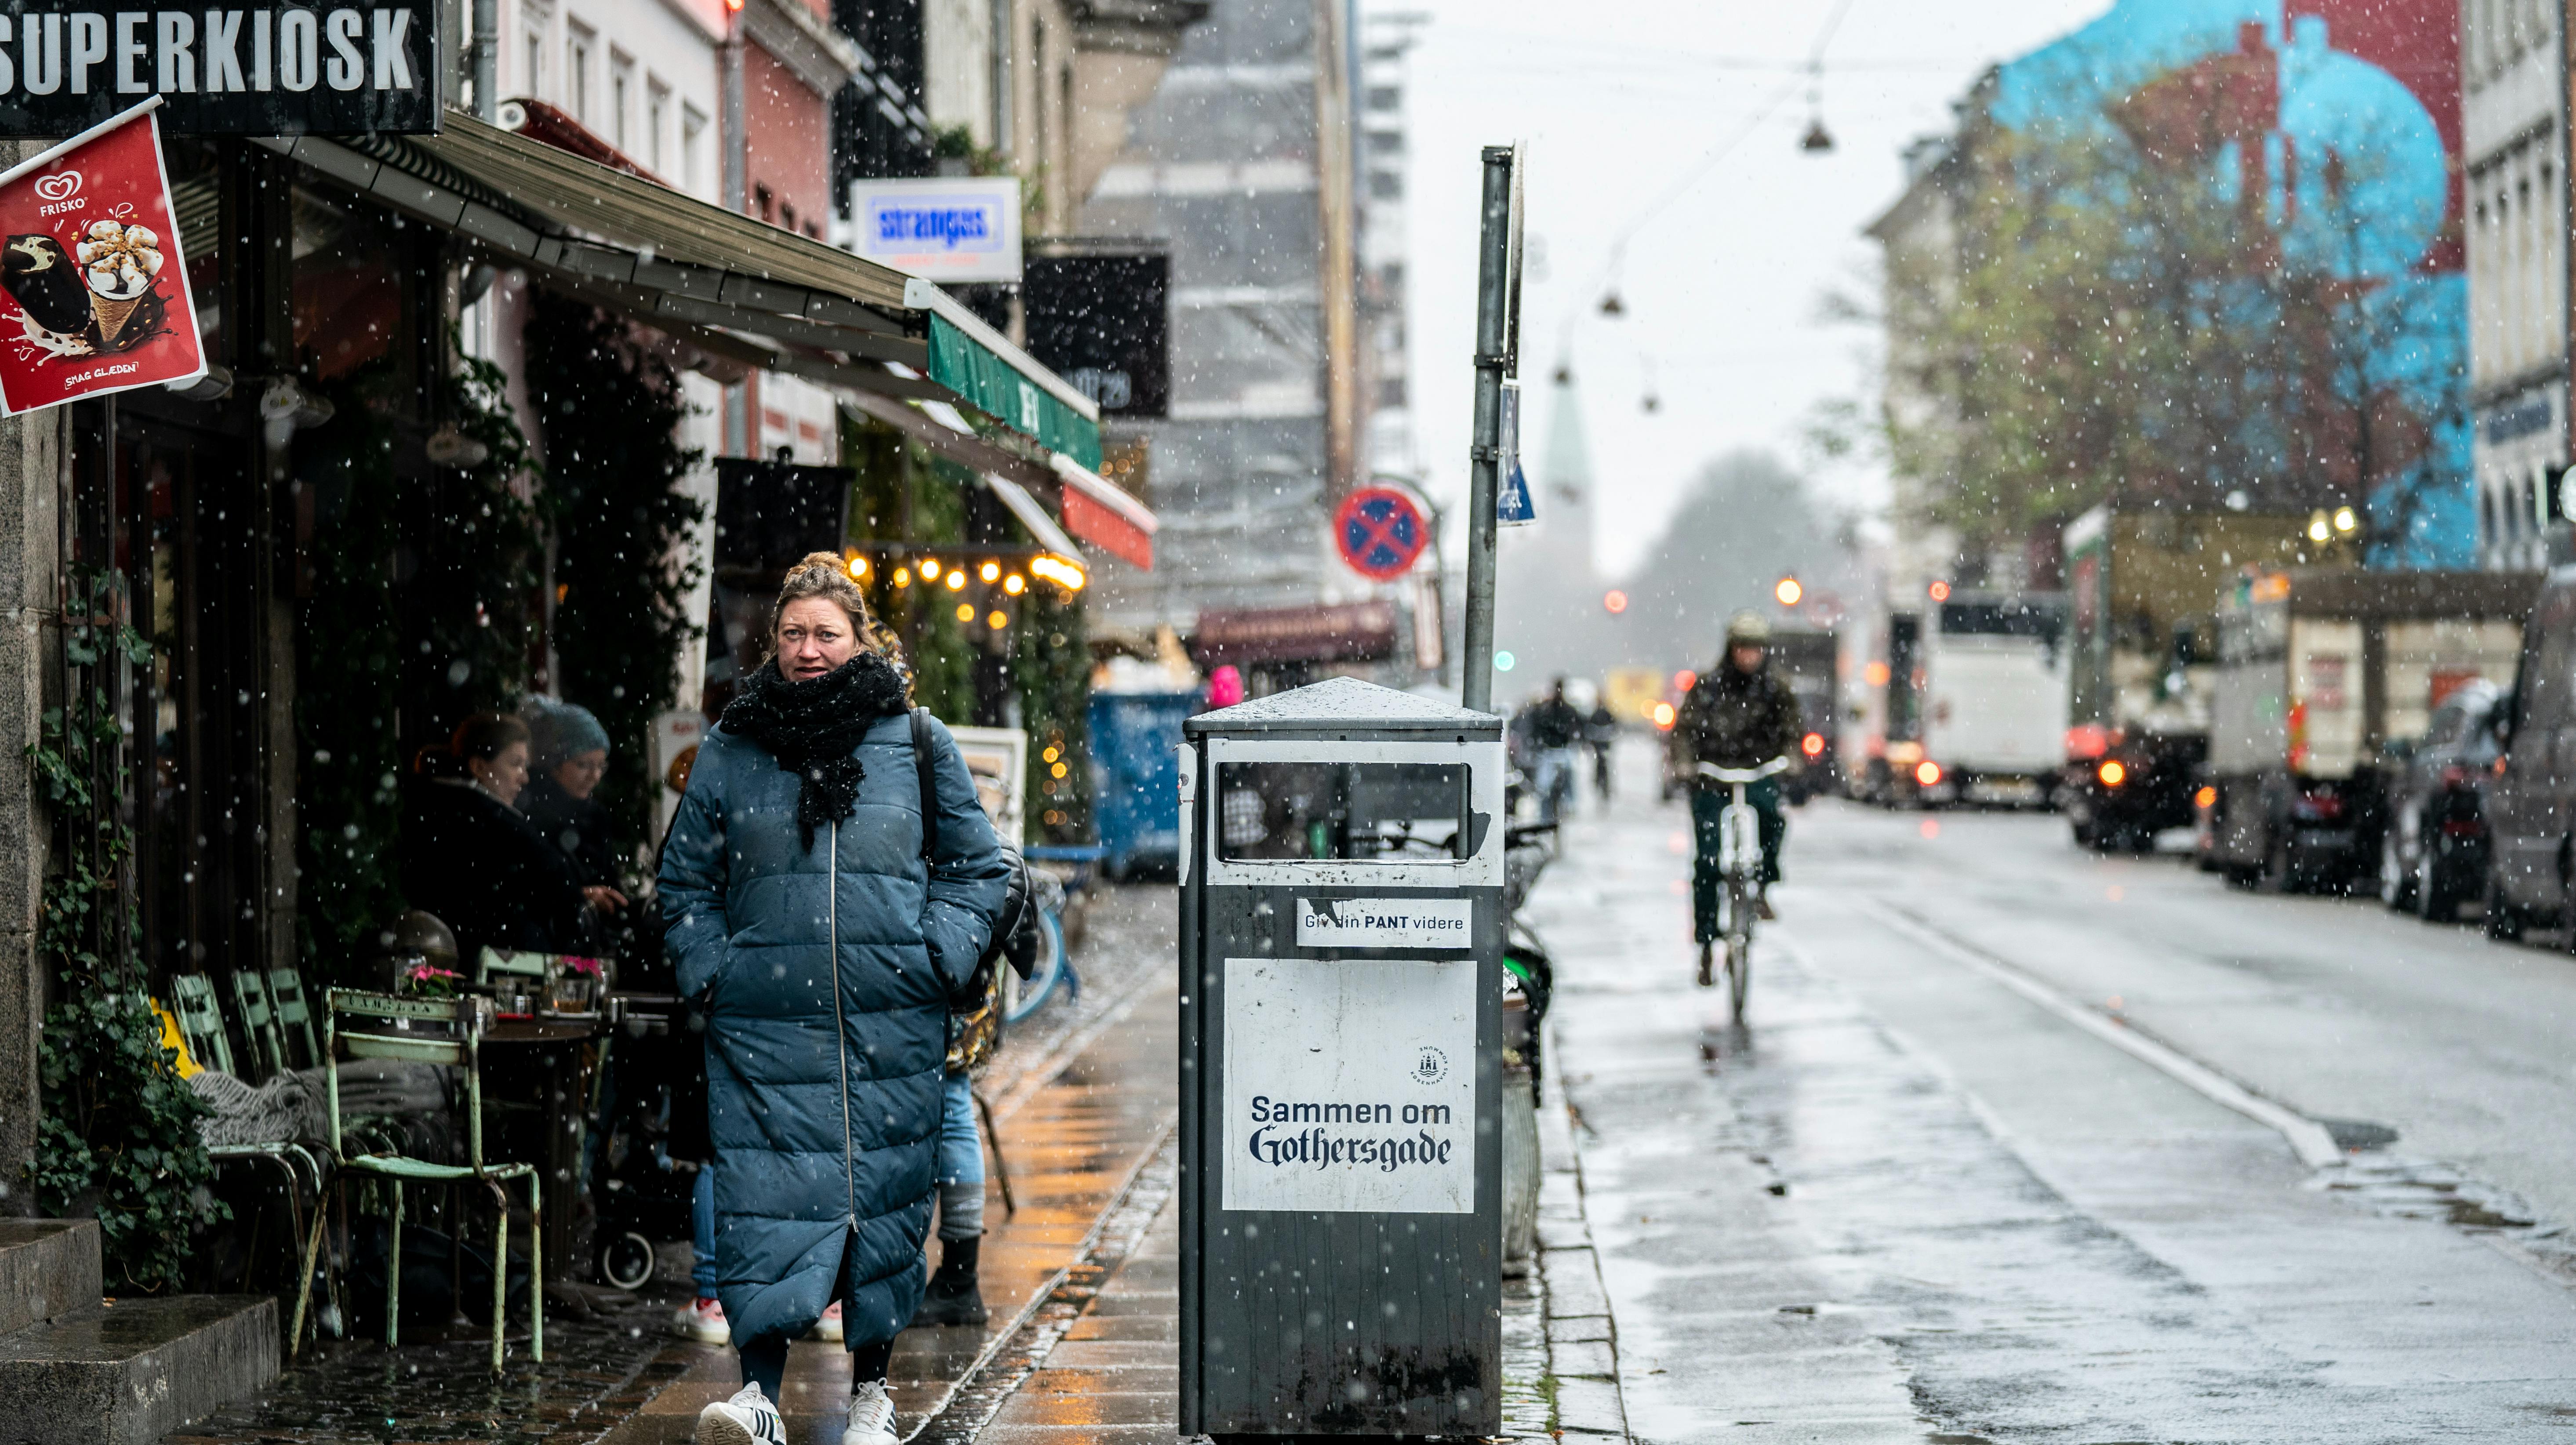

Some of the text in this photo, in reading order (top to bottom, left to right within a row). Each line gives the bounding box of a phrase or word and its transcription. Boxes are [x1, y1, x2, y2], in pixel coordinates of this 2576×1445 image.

[40, 198, 85, 217] FRISKO
[65, 363, 136, 387] SMAG GLÆDEN
[1305, 915, 1463, 929] Giv din PANT videre
[1410, 1046, 1448, 1086] KØBENHAVNS KOMMUNE
[1251, 1096, 1450, 1124] Sammen om
[1249, 1124, 1451, 1173] Gothersgade
